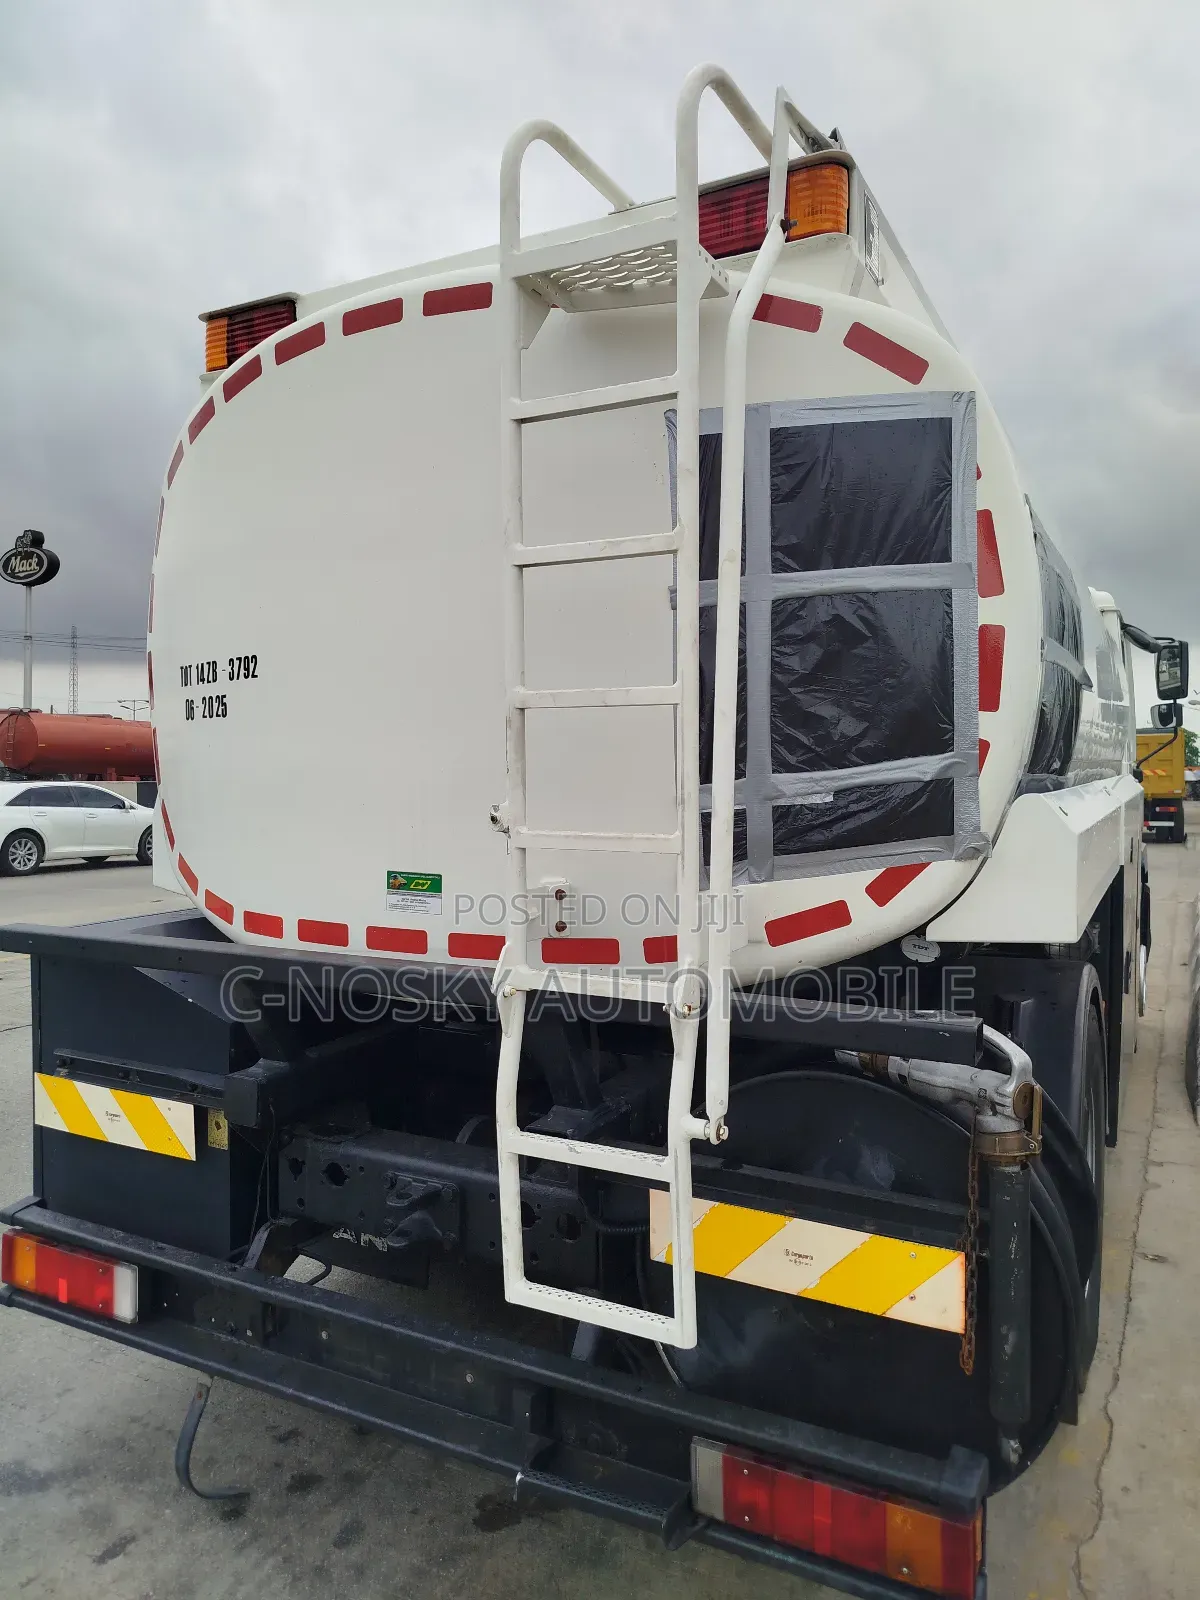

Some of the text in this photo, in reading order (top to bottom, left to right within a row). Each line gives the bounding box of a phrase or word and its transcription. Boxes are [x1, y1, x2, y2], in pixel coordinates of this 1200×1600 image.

[7, 553, 40, 574] Mack
[196, 660, 218, 685] 14ZB
[228, 655, 258, 681] 3792
